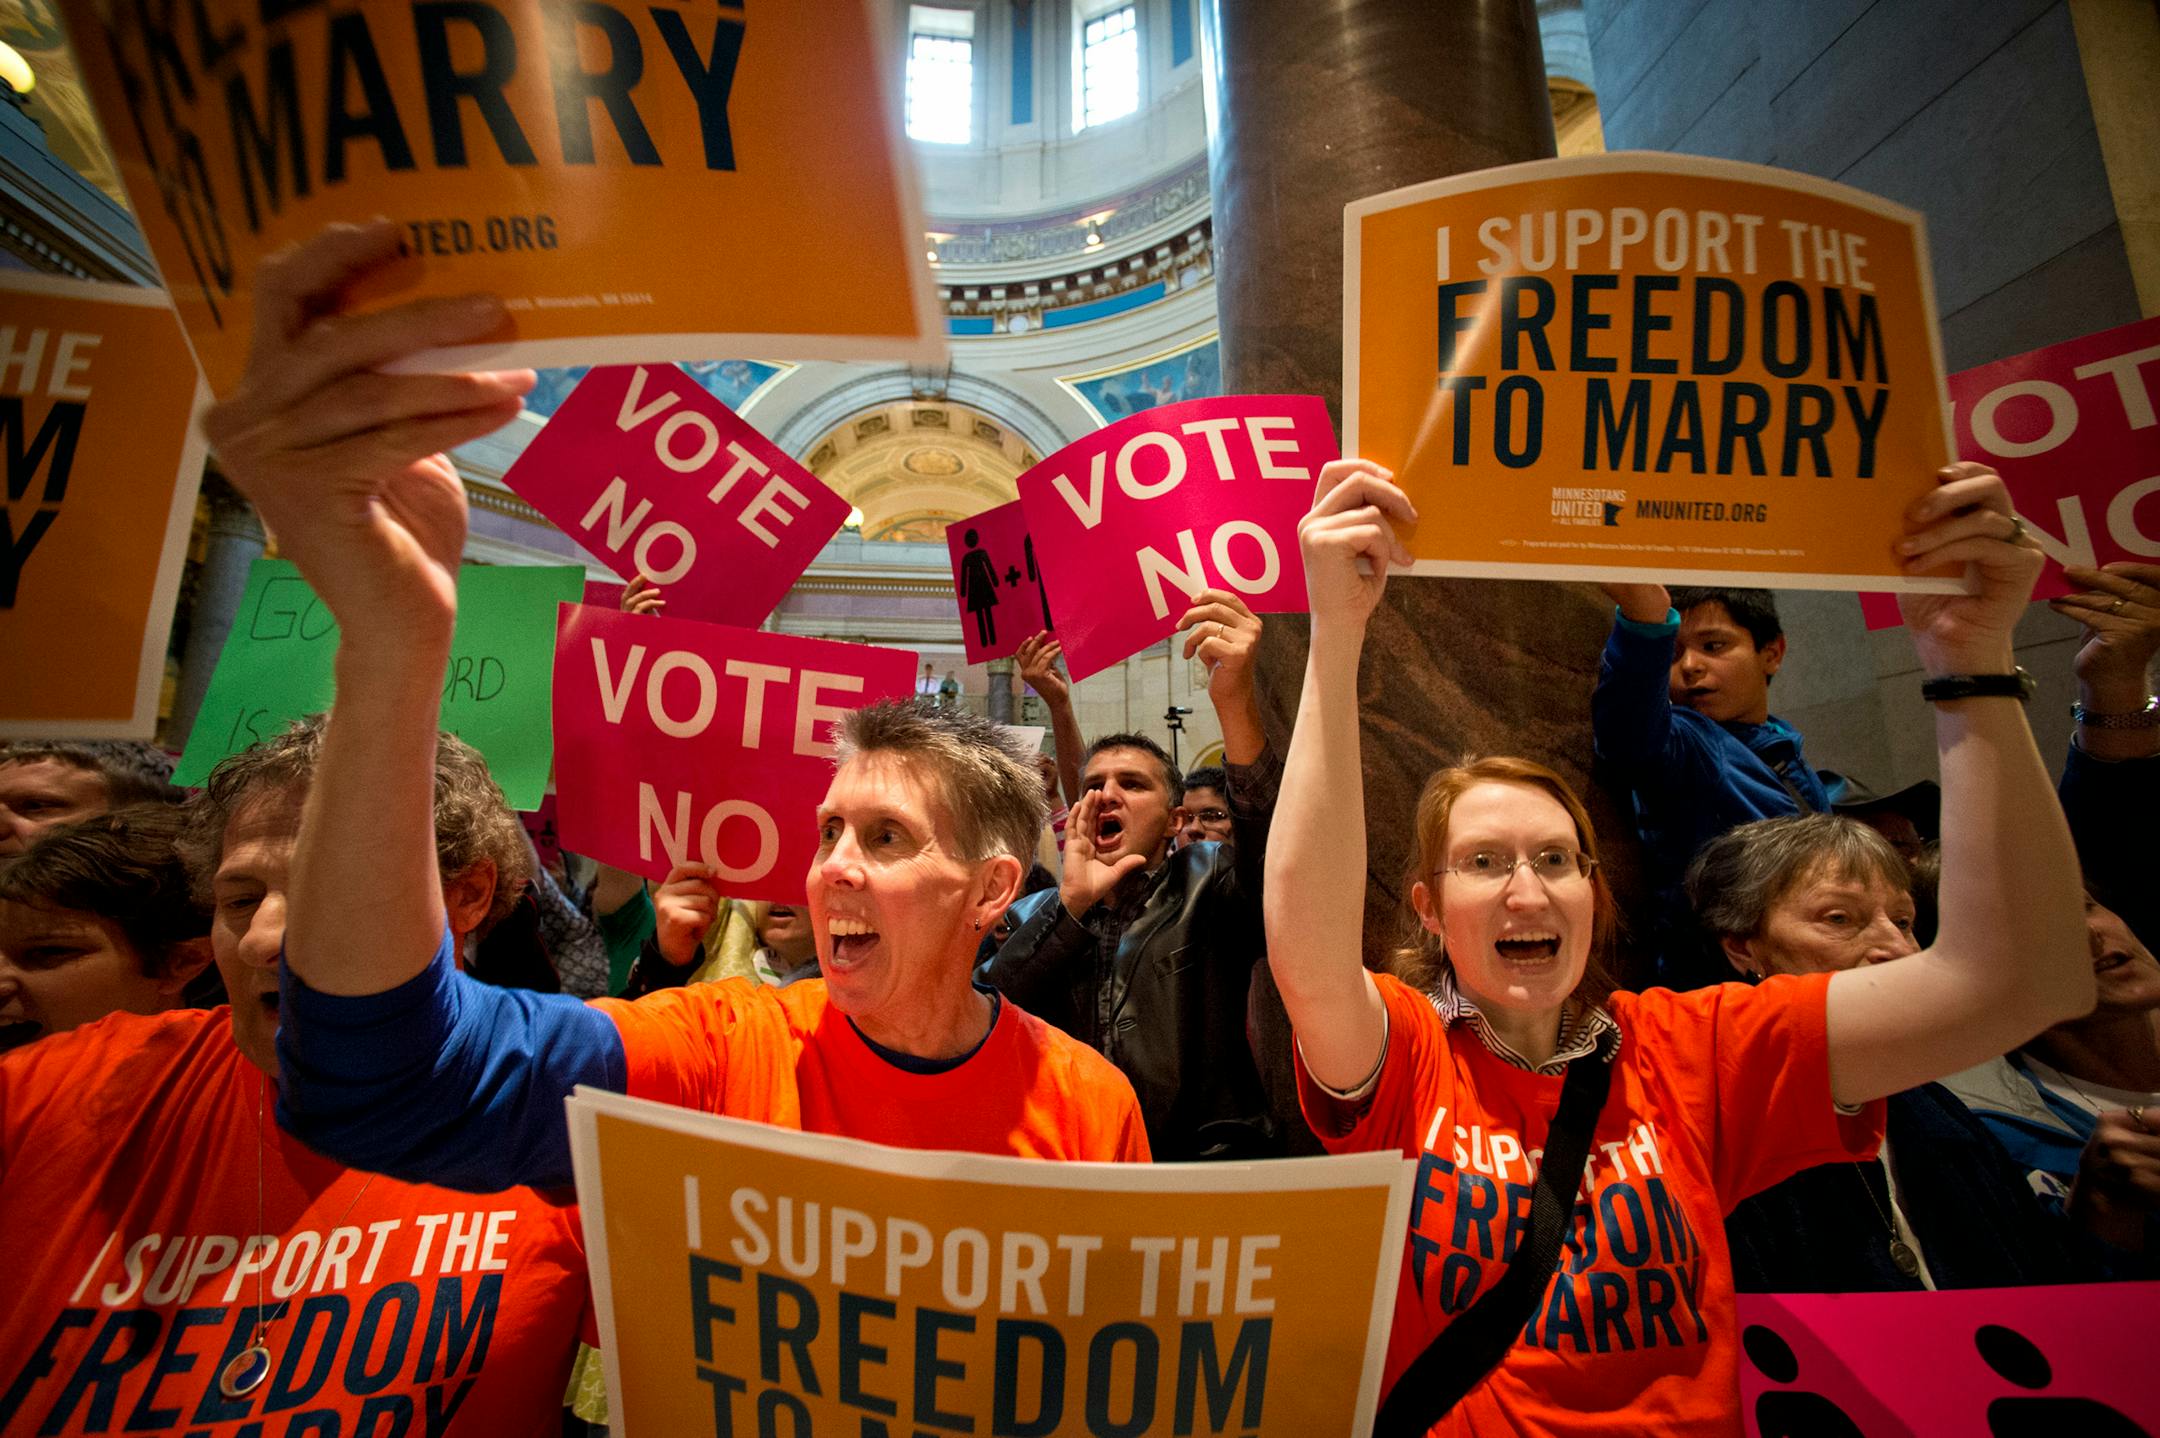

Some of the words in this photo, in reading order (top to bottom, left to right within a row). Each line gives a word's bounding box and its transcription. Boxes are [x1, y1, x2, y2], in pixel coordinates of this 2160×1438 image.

[226, 2, 748, 236] MARRY
[400, 215, 558, 259] TED.ORG
[1437, 226, 1450, 282] I
[1477, 208, 1764, 275] SUPPORT
[1780, 219, 1876, 292] THE
[0, 326, 103, 399] HE
[1437, 274, 1889, 384] FREEDOM
[1438, 374, 1545, 469] TO
[1582, 377, 1890, 479] MARRY
[1950, 345, 2160, 458] OT
[616, 365, 811, 549] VOTE
[1051, 416, 1311, 530] VOTE
[1551, 500, 1602, 518] UNITED
[1552, 487, 1627, 503] MINNESOTANS
[579, 476, 697, 585] NO
[1636, 500, 1767, 523] MNUNITED.ORG
[1136, 520, 1280, 621] NO
[591, 637, 864, 760] VOTE
[639, 781, 779, 884] NO
[1423, 1106, 1447, 1151] I
[1453, 1125, 1598, 1202] SUPT
[1601, 1121, 1664, 1181] TH
[70, 1232, 118, 1303] I
[102, 1219, 401, 1307] SUPPORT
[410, 1210, 517, 1278] THE
[684, 1174, 701, 1249] I
[730, 1187, 1102, 1317] SUPPORT
[1130, 1235, 1281, 1317] THE
[1411, 1151, 1701, 1275] FREDOM
[1410, 1232, 1482, 1316] TO
[0, 1273, 505, 1438] FREEDOM
[688, 1253, 1273, 1438] FREEDOM
